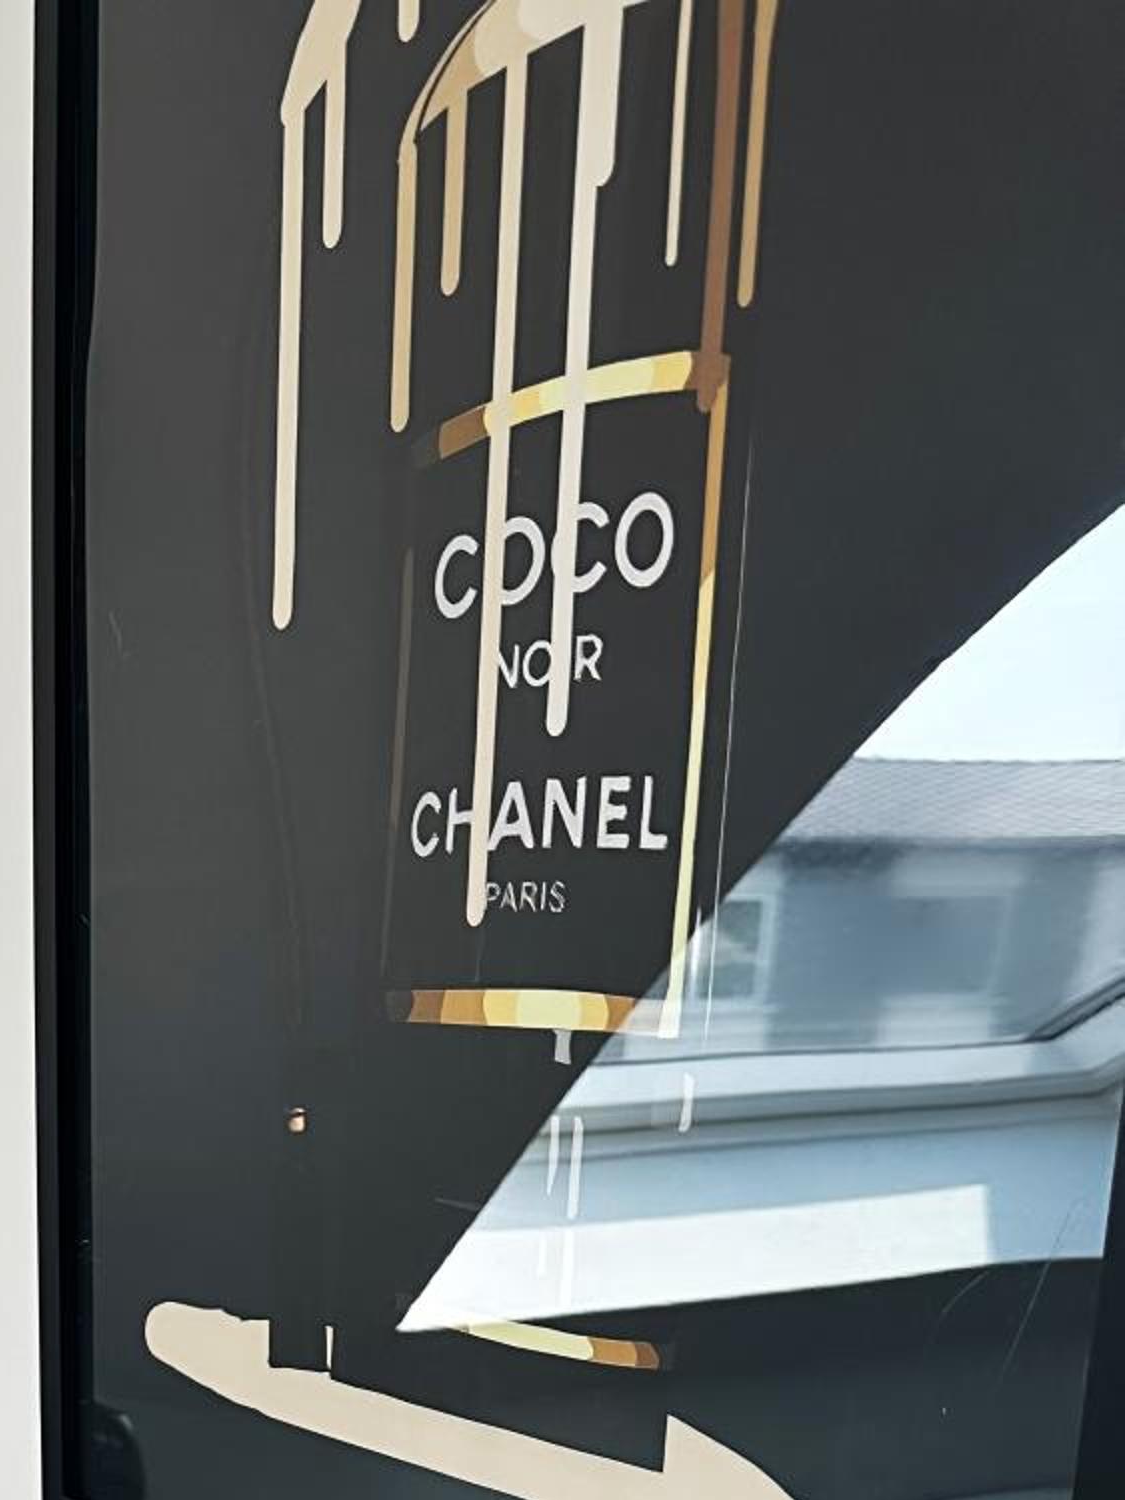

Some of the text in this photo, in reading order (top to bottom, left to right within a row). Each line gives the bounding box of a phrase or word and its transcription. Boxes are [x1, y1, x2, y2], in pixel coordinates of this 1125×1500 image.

[498, 633, 604, 689] NOR
[410, 775, 669, 857] CHANEL
[486, 881, 566, 912] PARIS
